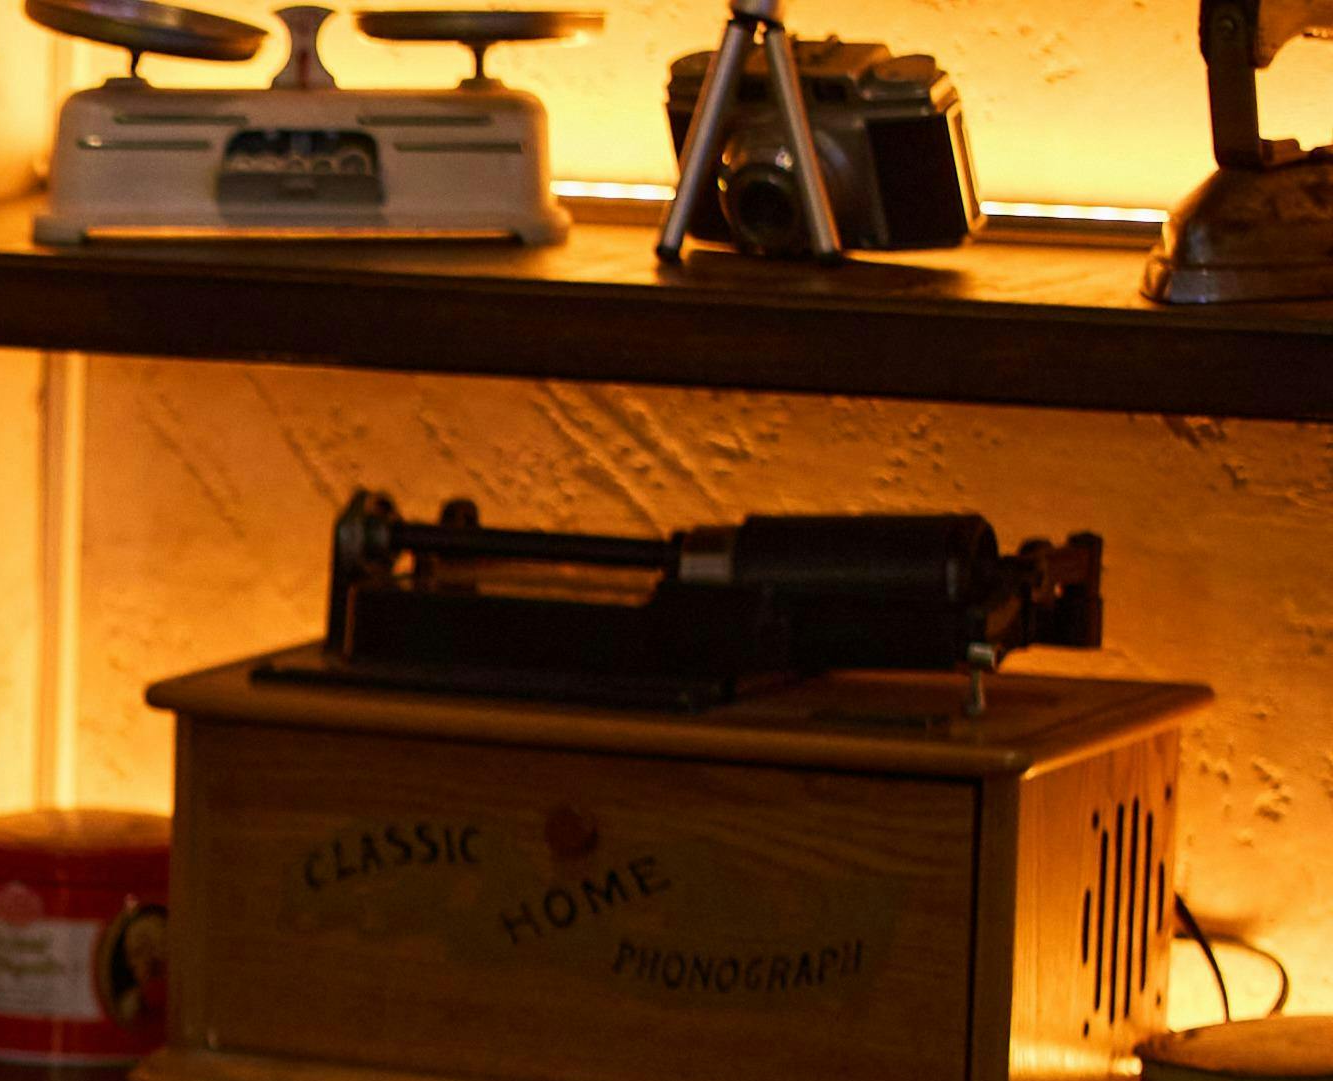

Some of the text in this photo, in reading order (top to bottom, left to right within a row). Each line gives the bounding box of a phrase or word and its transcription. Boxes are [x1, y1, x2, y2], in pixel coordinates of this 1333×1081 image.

[303, 823, 480, 890] CLASSIC
[499, 855, 673, 945] HOME
[612, 938, 864, 993] PHONOGRAPH
